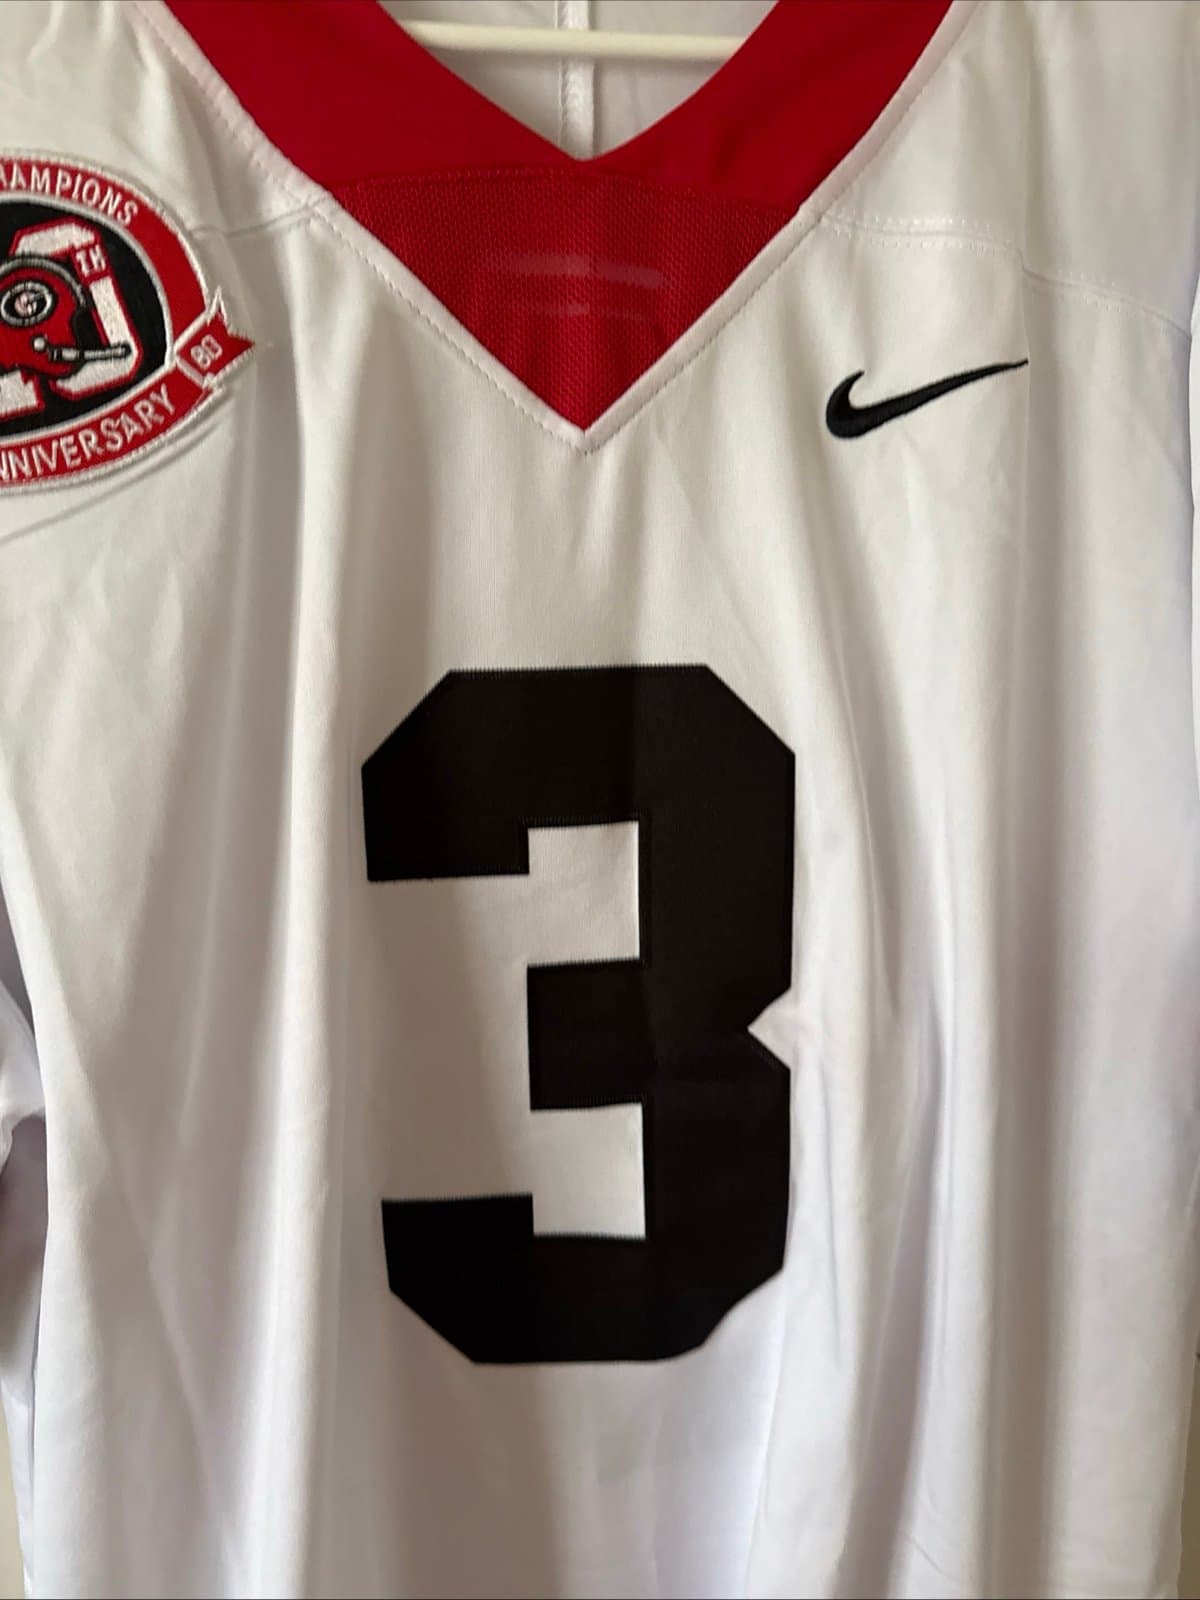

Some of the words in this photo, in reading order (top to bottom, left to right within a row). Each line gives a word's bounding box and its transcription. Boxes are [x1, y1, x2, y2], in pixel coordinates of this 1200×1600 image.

[75, 244, 106, 277] TH
[190, 334, 223, 370] 80
[361, 664, 795, 1364] 3
